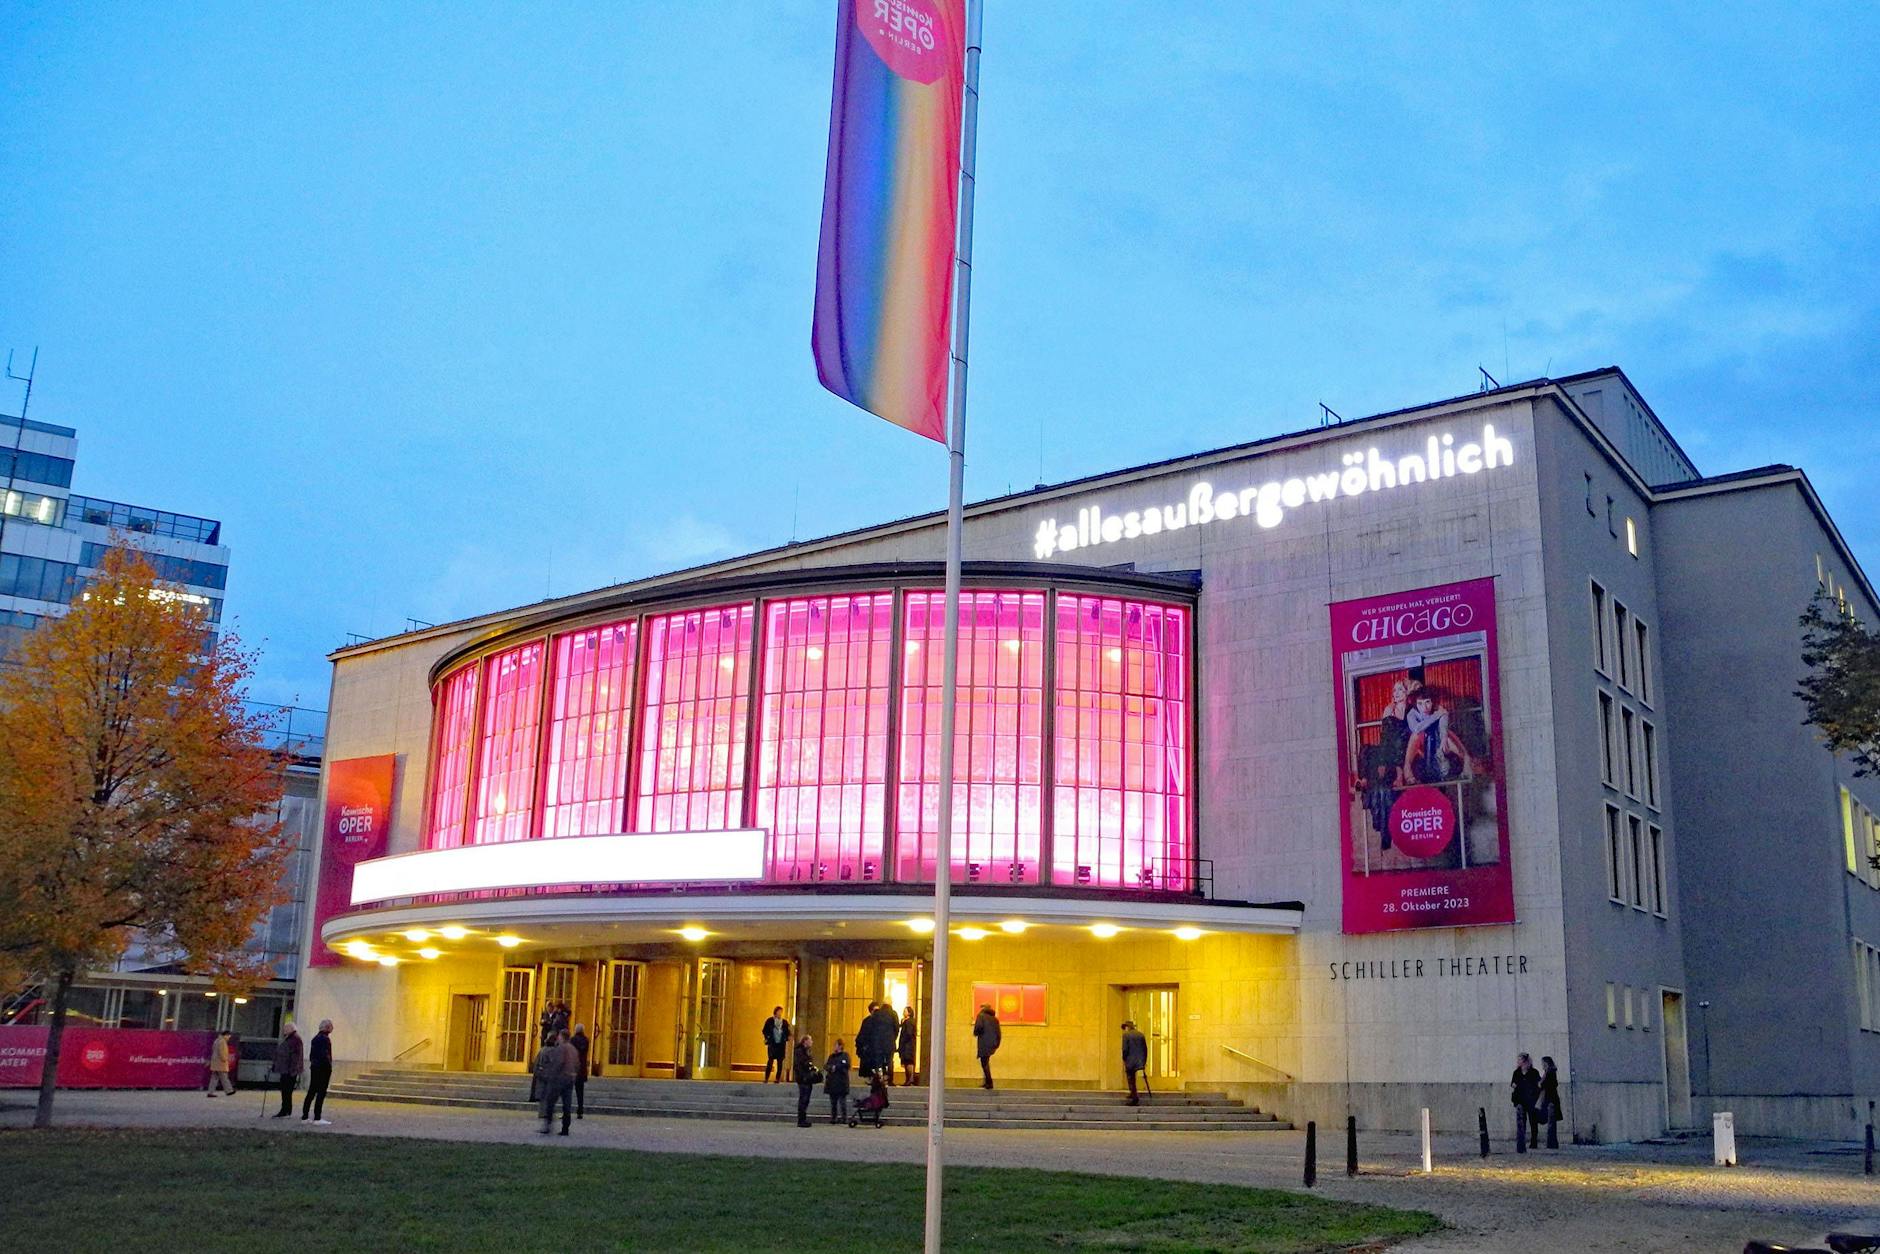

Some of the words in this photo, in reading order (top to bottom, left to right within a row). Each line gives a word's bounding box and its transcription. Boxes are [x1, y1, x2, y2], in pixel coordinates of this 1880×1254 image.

[1034, 424, 1514, 560] #allesaußergewöhnlich
[1361, 608, 1377, 616] WER
[1378, 602, 1408, 613] SKRUPEL
[1401, 806, 1443, 819] Komische
[338, 815, 373, 834] OPER
[1400, 816, 1443, 833] OPER
[1401, 885, 1450, 898] PREMIERE
[1382, 902, 1399, 913] 28.
[1401, 901, 1441, 912] Oktober
[1443, 897, 1470, 909] 2023
[1329, 959, 1425, 980] SCHILLER
[1437, 955, 1528, 977] THEATER
